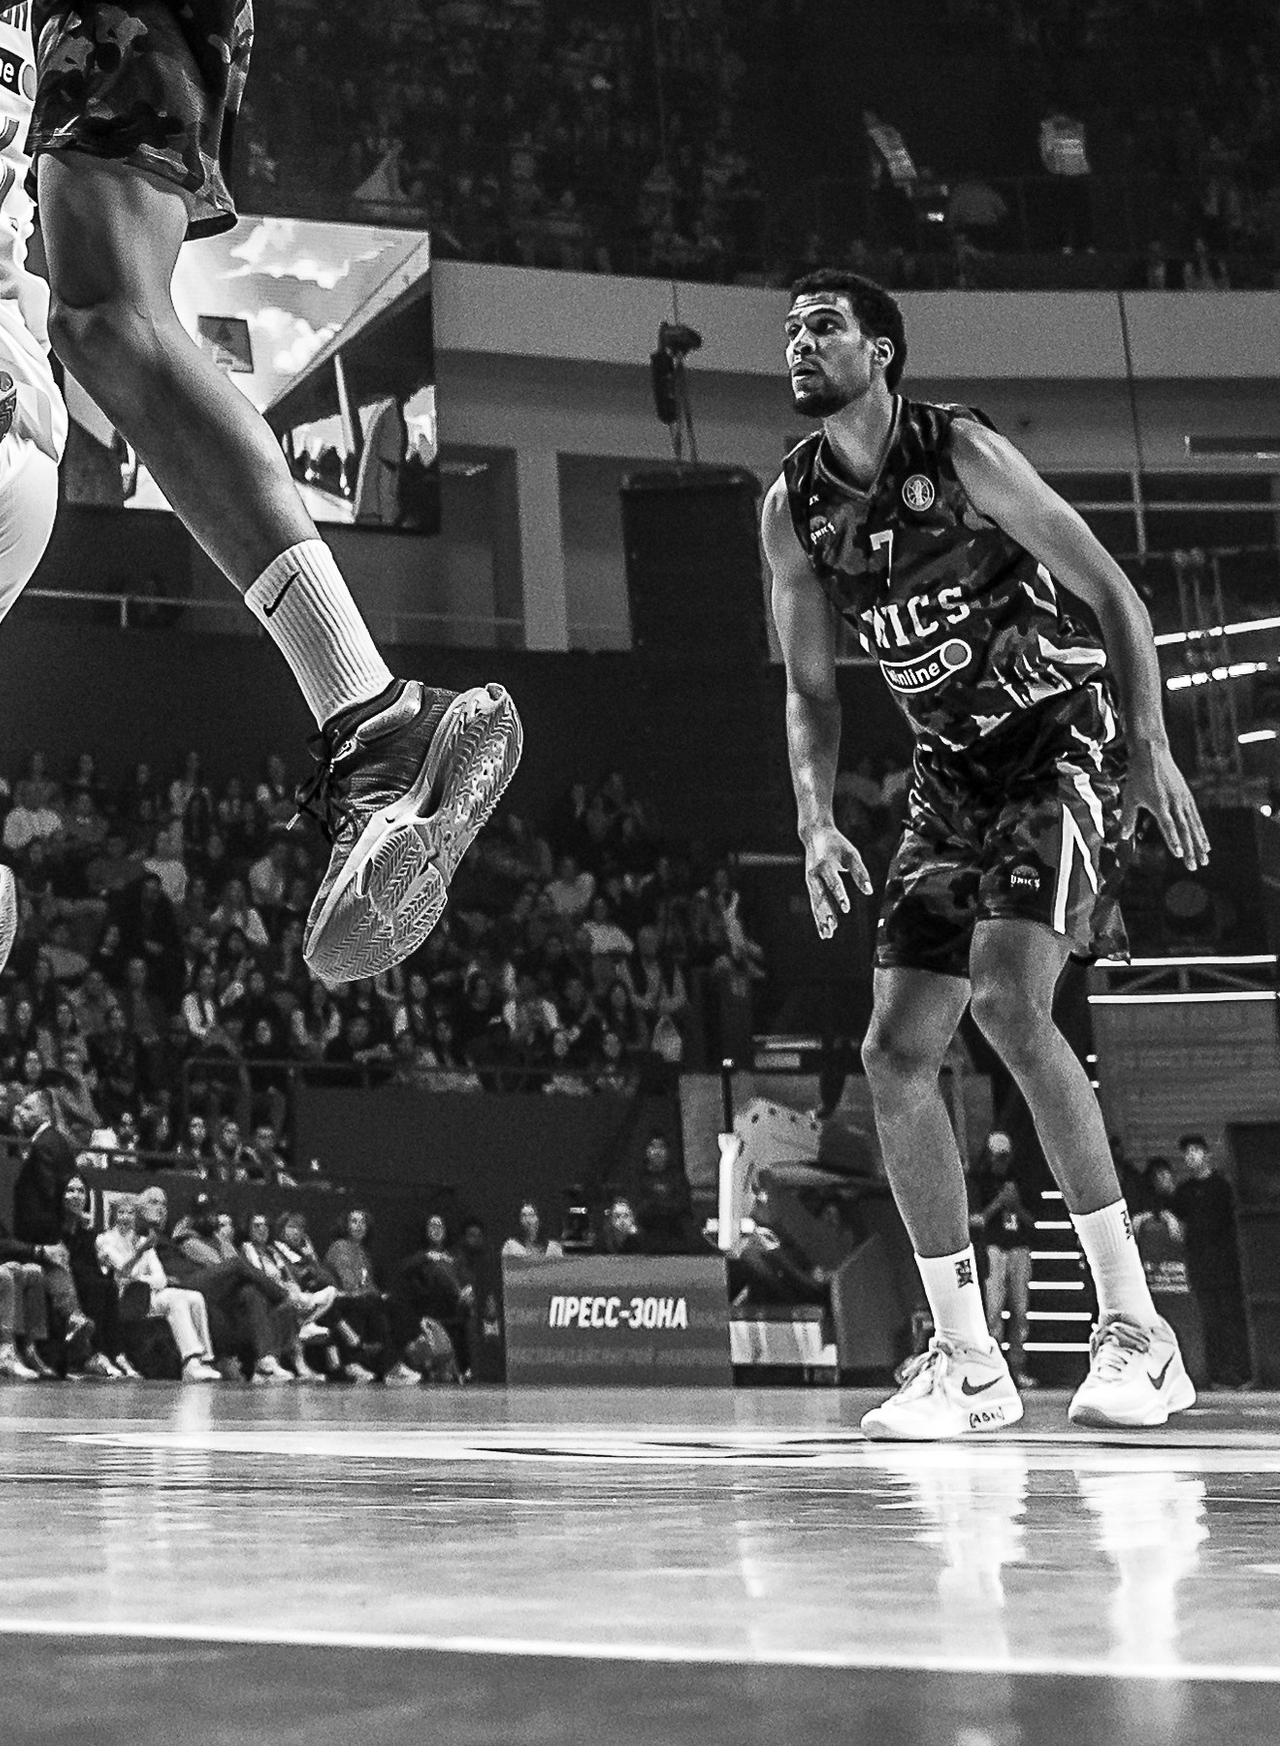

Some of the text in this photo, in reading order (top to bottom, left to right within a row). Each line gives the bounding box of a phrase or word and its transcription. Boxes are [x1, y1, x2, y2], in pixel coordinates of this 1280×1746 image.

[869, 529, 895, 589] 7
[859, 586, 970, 653] NICS
[548, 1295, 689, 1330] ПРЕСС-ЗОНА
